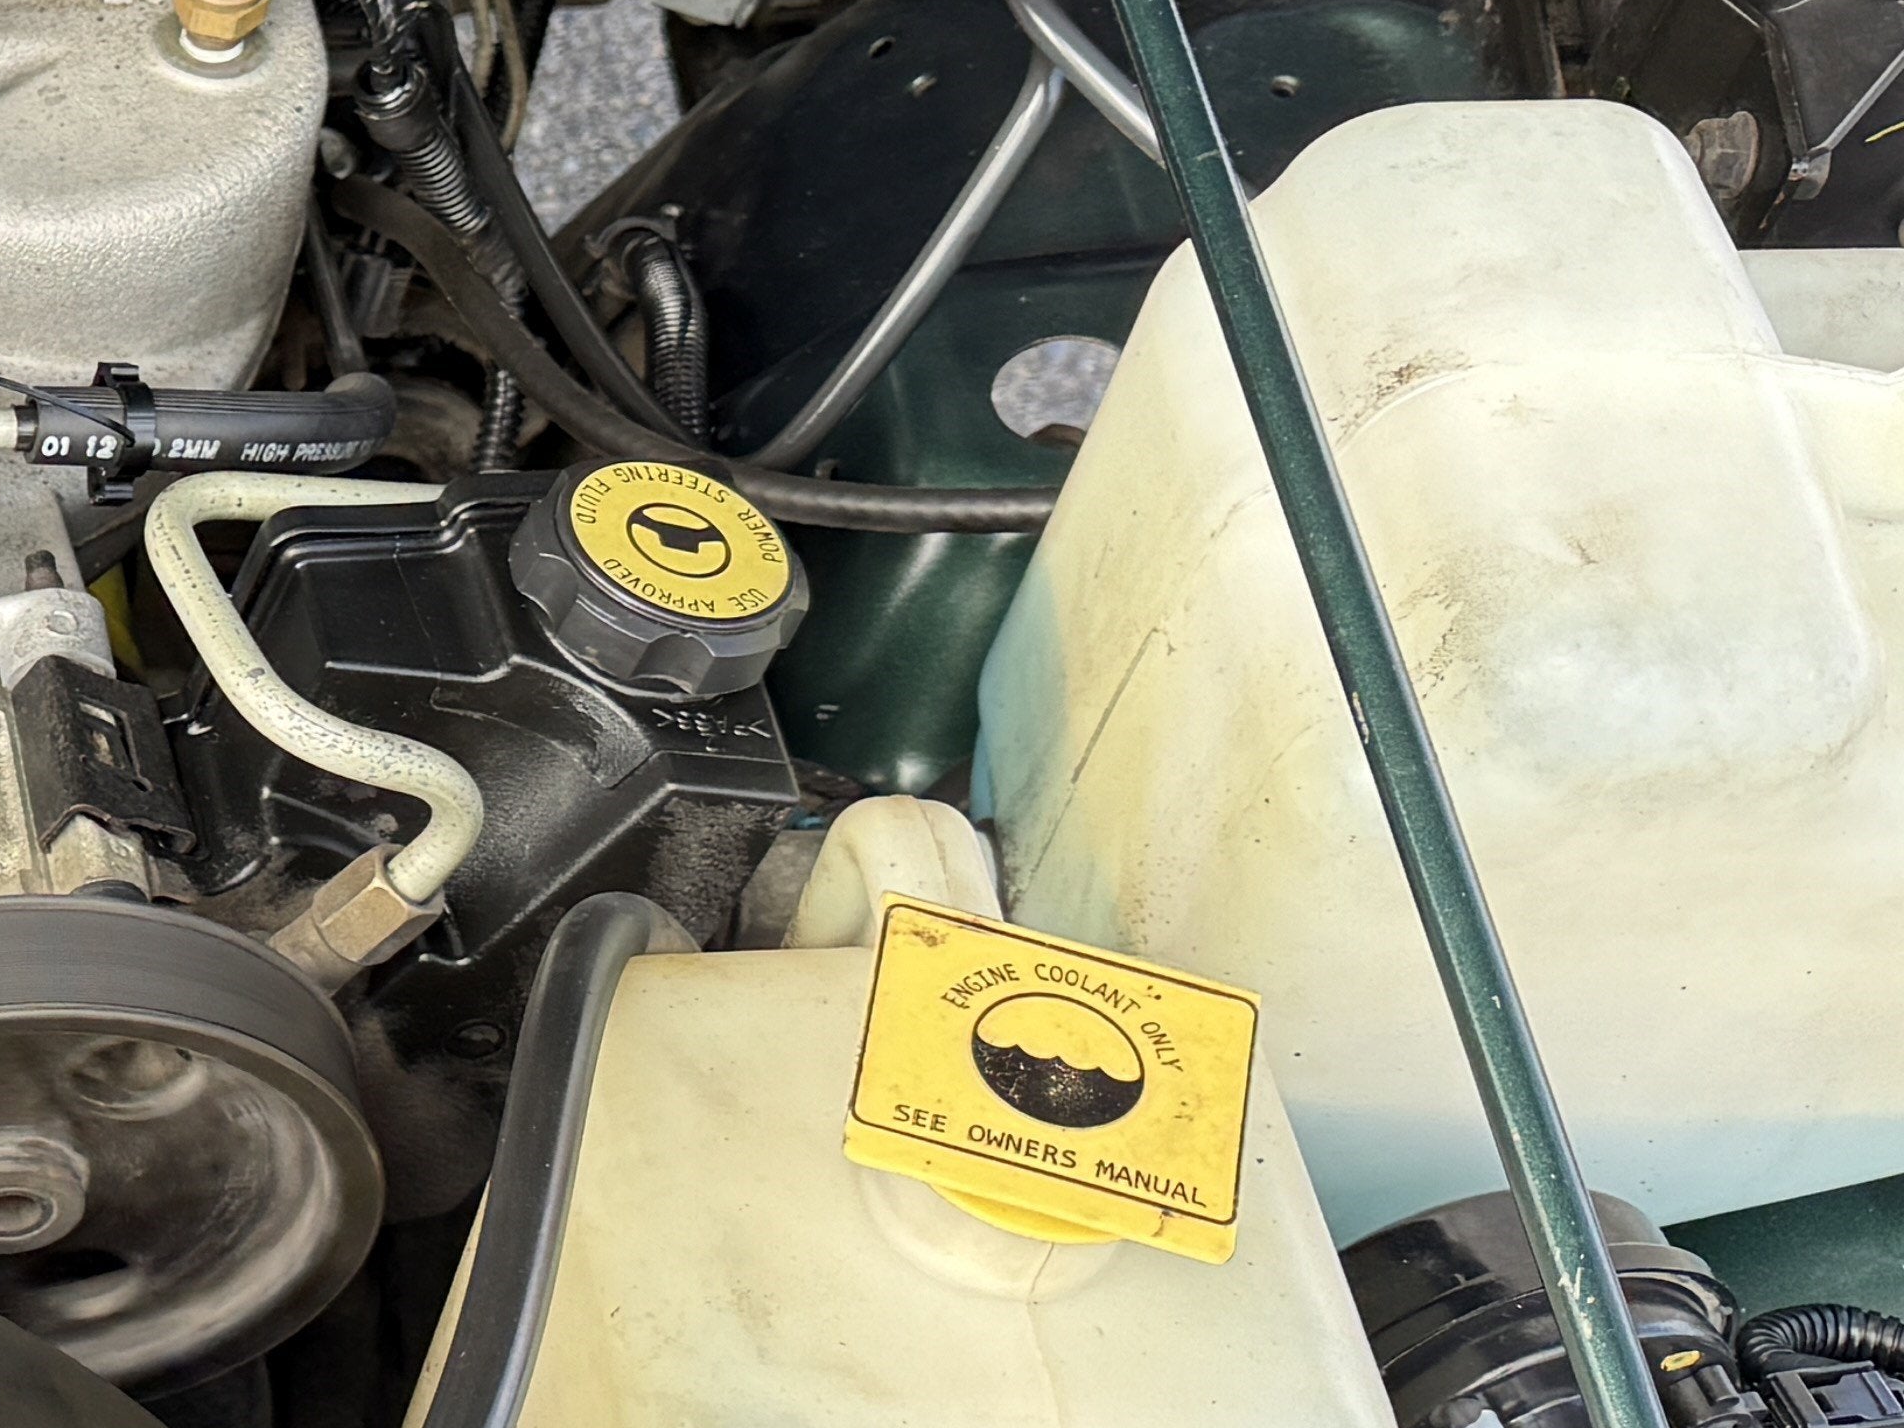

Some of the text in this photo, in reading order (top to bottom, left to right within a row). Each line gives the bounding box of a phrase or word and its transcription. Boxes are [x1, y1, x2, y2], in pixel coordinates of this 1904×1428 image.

[41, 435, 71, 458] 01
[241, 441, 291, 464] HIGH
[575, 464, 785, 564] POWER STEERING FLUID
[601, 557, 770, 614] USE APPROVED
[941, 961, 1187, 1074] ENGINE COOLANT ONLY
[892, 1102, 1209, 1209] SEE OWNERS MANUAL
